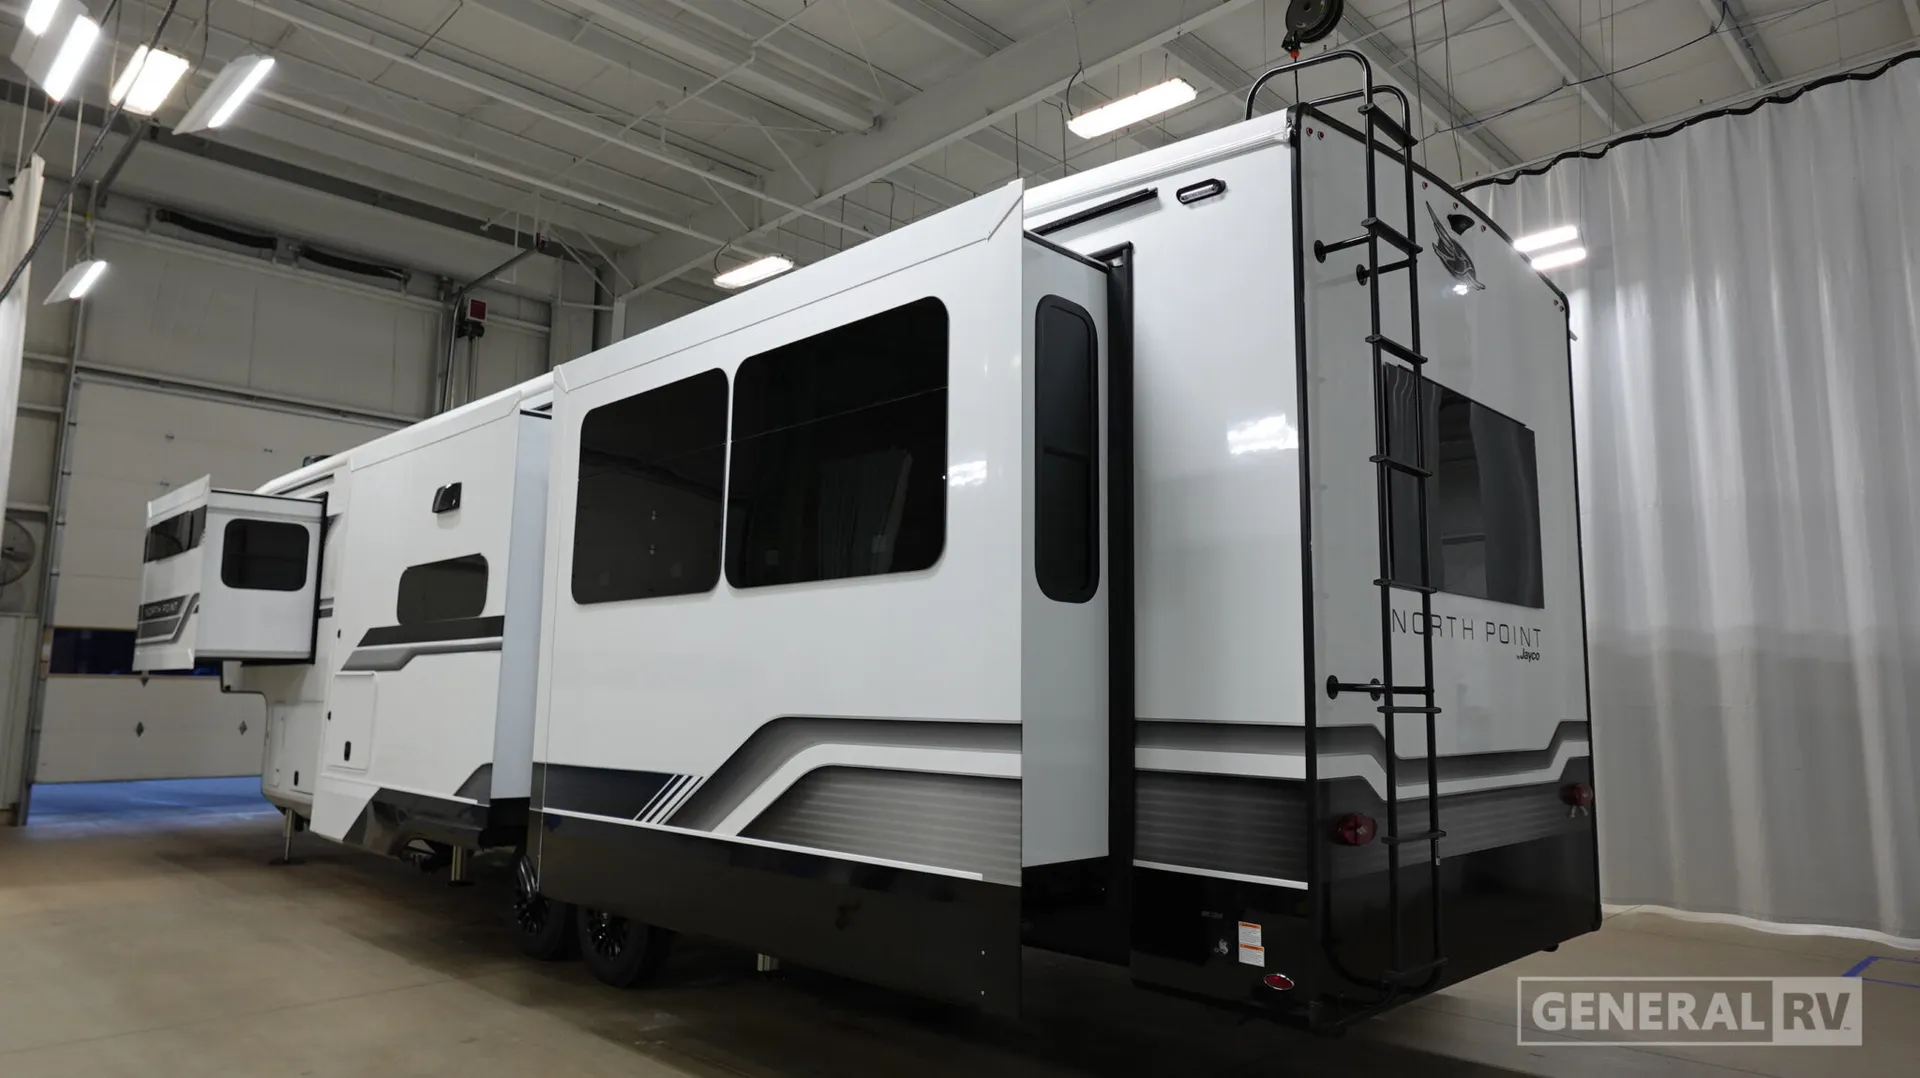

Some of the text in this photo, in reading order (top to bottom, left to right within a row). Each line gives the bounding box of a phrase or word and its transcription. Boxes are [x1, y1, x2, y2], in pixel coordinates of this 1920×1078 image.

[1392, 609, 1541, 648] NORTH POINT
[1520, 648, 1540, 663] Jayco
